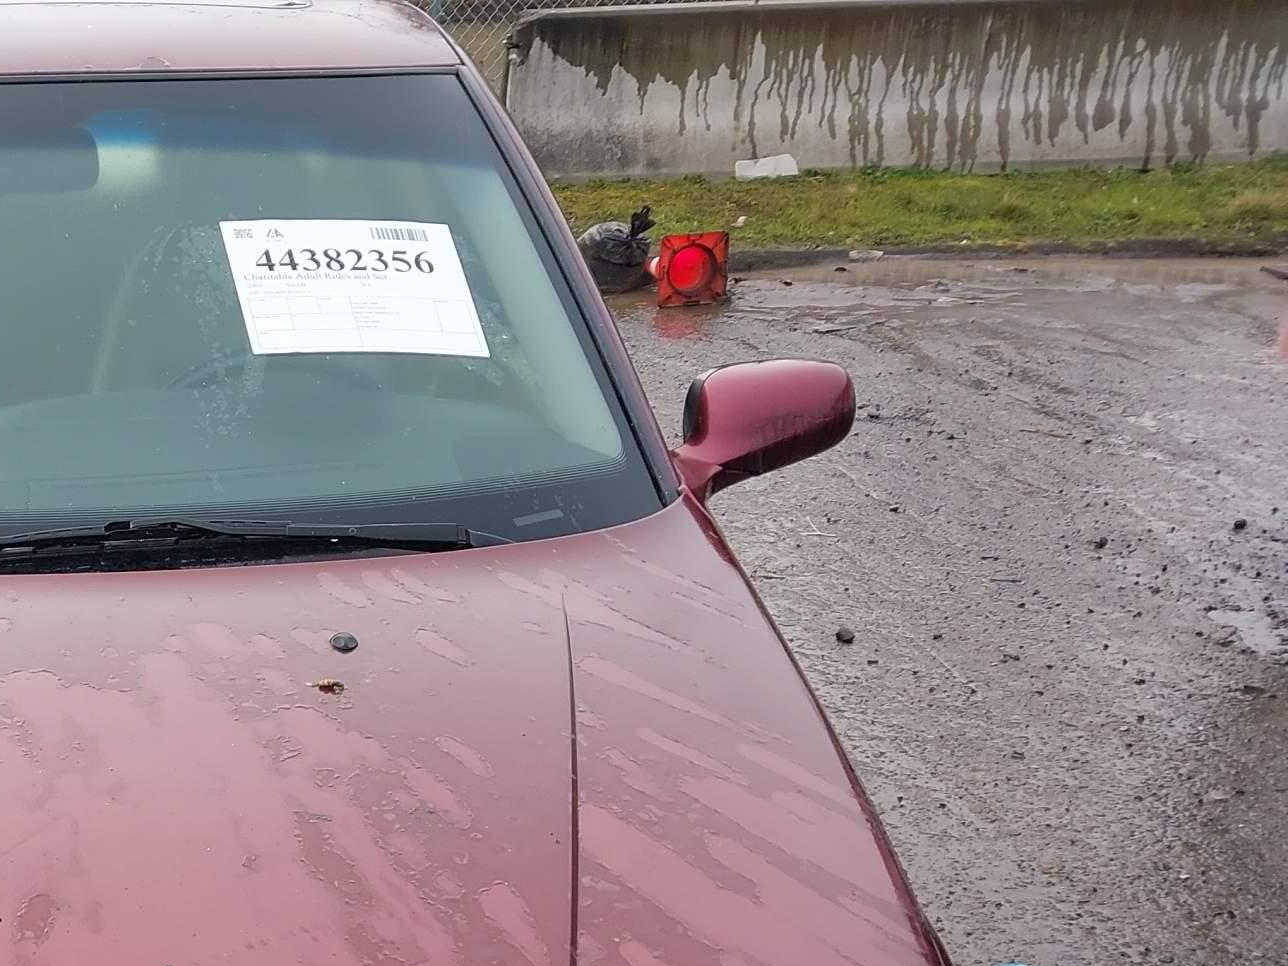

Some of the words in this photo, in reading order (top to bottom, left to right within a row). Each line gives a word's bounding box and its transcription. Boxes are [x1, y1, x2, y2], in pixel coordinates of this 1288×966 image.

[255, 248, 434, 273] 44382356
[296, 272, 322, 280] Adult
[353, 272, 371, 280] and
